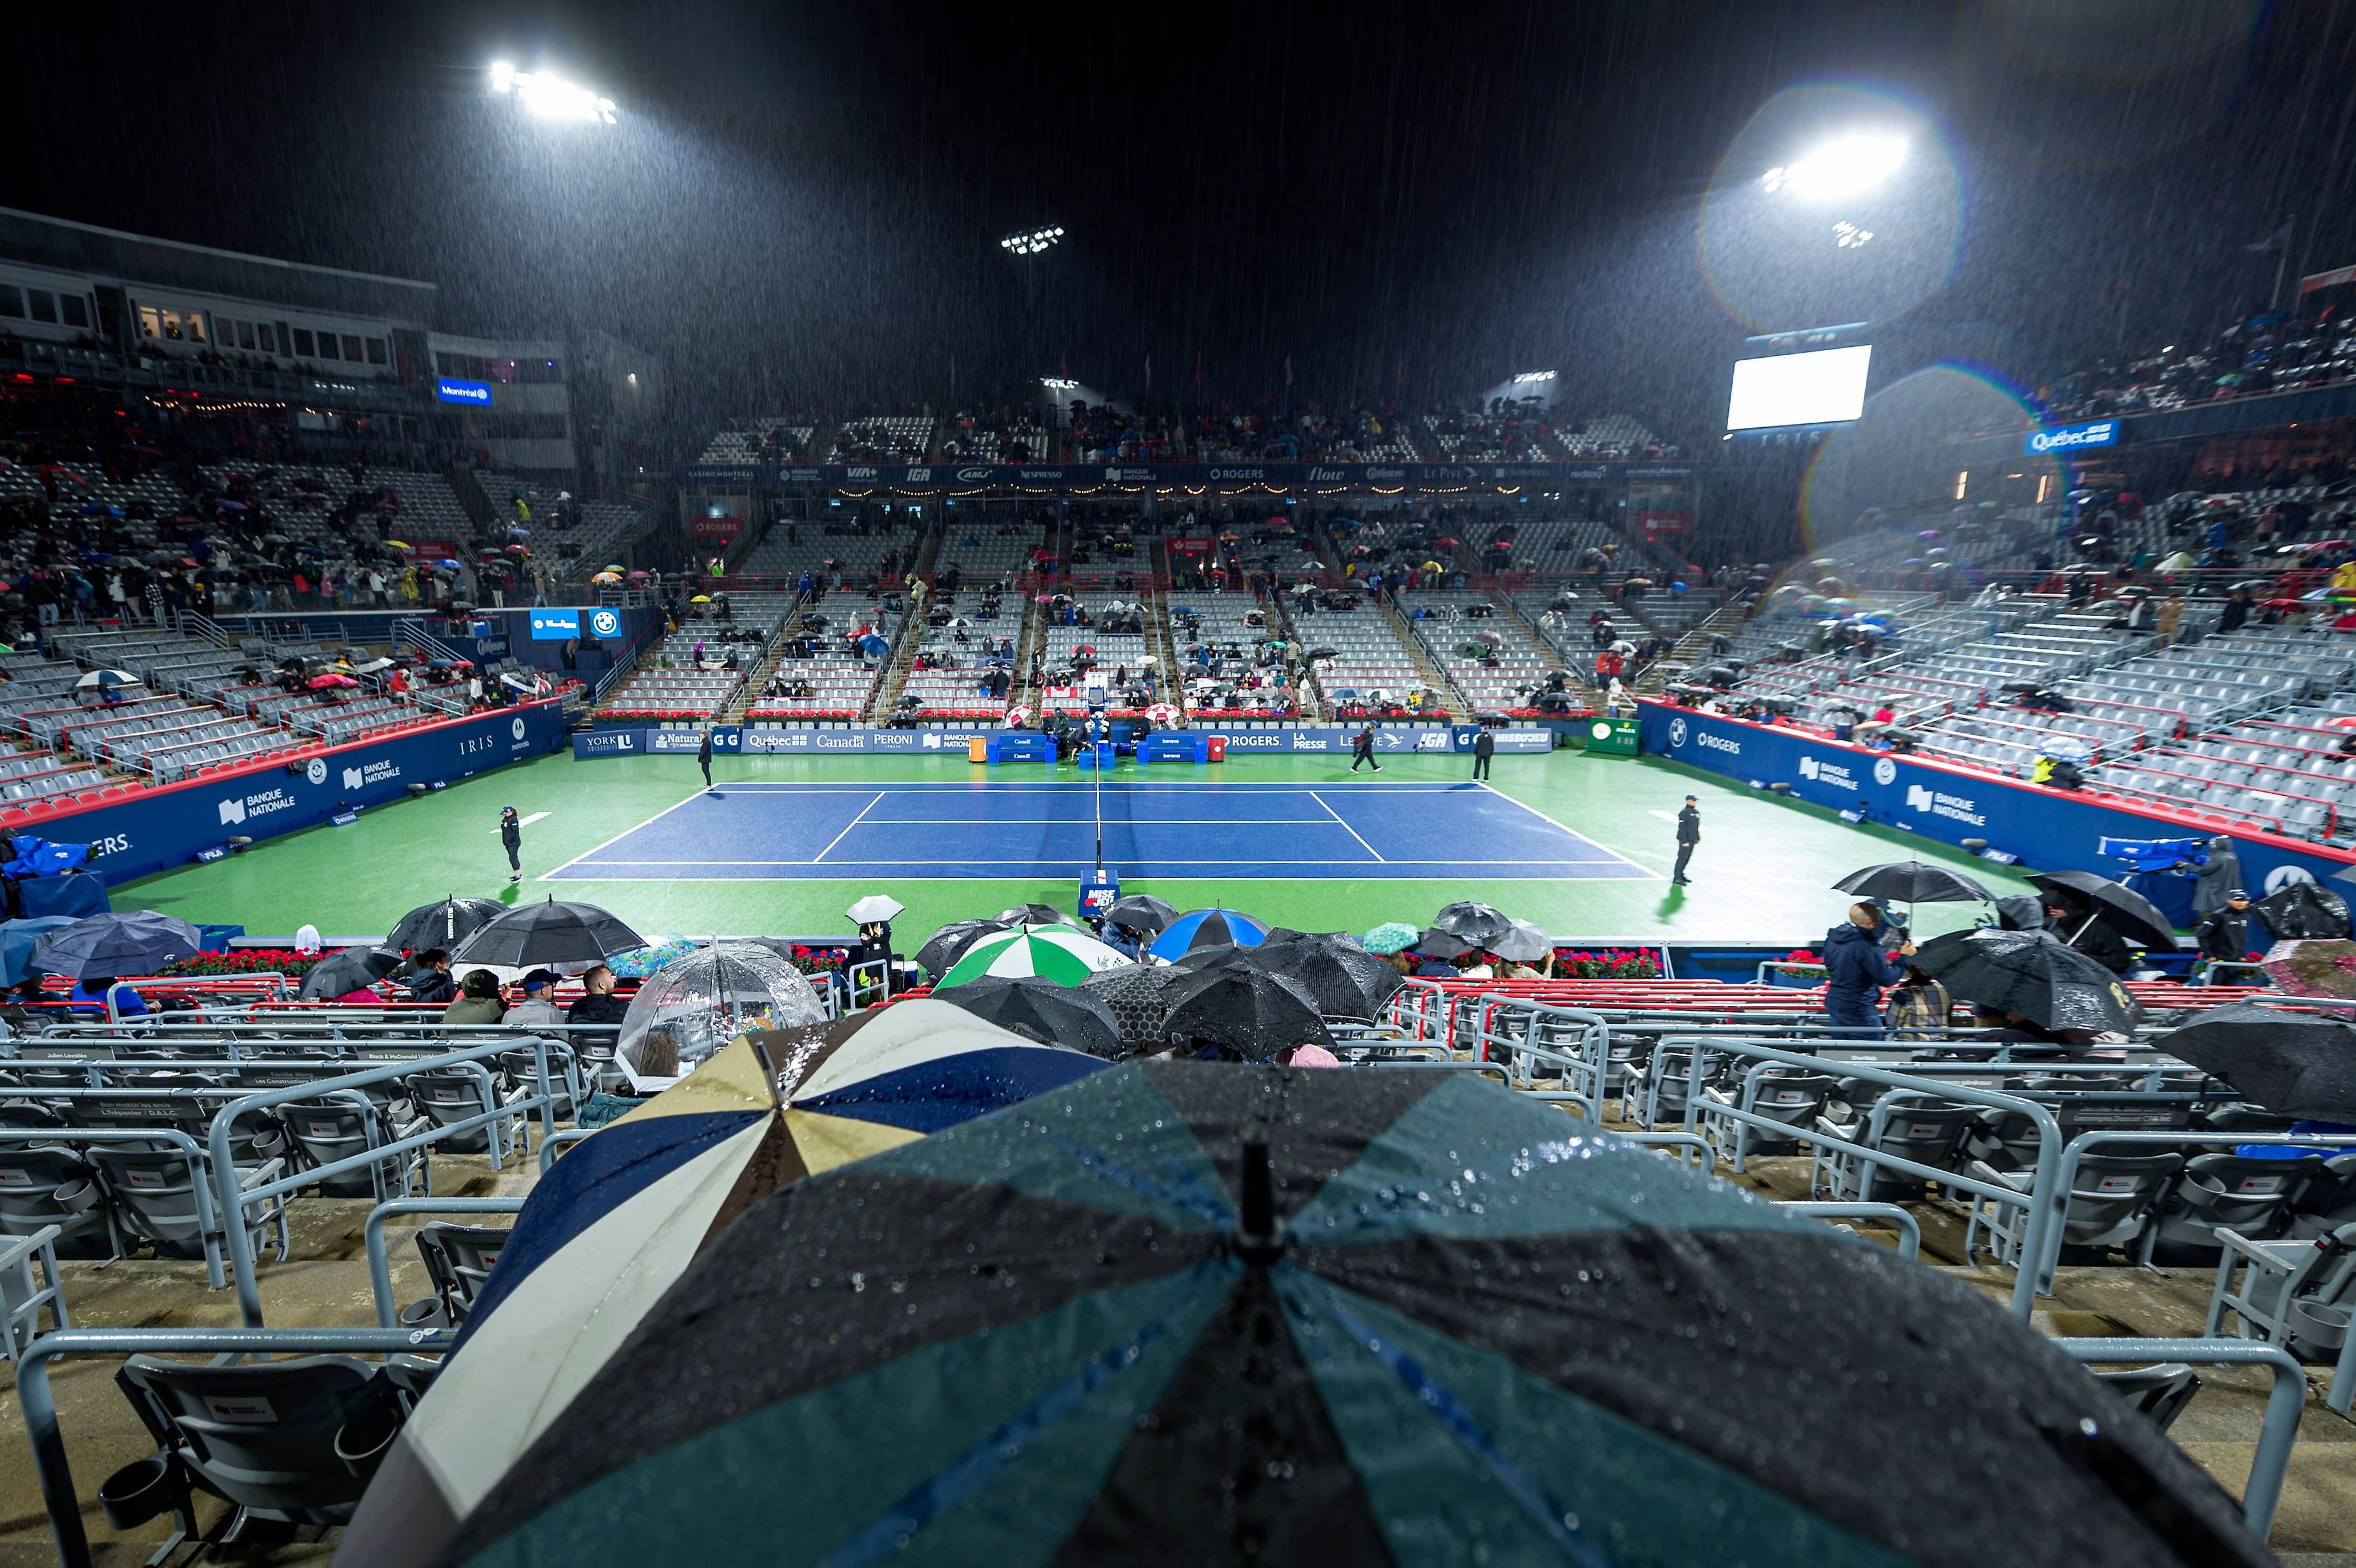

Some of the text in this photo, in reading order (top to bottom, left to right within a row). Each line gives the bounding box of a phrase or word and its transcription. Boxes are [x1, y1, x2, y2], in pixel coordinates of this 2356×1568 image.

[442, 386, 477, 397] Montréal
[2032, 430, 2087, 451] Québec
[848, 468, 870, 477] VIA
[907, 469, 930, 481] IGA
[1223, 470, 1263, 478] ROGERS
[1310, 467, 1344, 481] flow
[706, 523, 737, 532] ROGERS
[460, 735, 493, 754] IRIS
[587, 737, 616, 746] YORK
[714, 735, 738, 745] G G
[749, 734, 791, 747] Québec
[816, 735, 864, 747] Canada
[874, 734, 912, 744] PERONI
[1294, 740, 1326, 749] PRESSE
[1419, 733, 1447, 747] IGA
[1459, 734, 1469, 745] G
[1707, 736, 1740, 754] ROGERS
[512, 740, 529, 751] motorola
[364, 760, 391, 774] BANQUE
[1820, 763, 1850, 777] BANQUE
[365, 767, 400, 784] NATIONALE
[1819, 772, 1859, 790] NATIONALE
[247, 788, 282, 805] BANQUE
[1934, 793, 1975, 810] BANQUE
[249, 796, 295, 817] NATIONALE
[339, 814, 357, 823] ROGERS
[1933, 803, 1986, 826] NATIONALE
[205, 850, 224, 860] FILA
[1088, 889, 1116, 898] MISE
